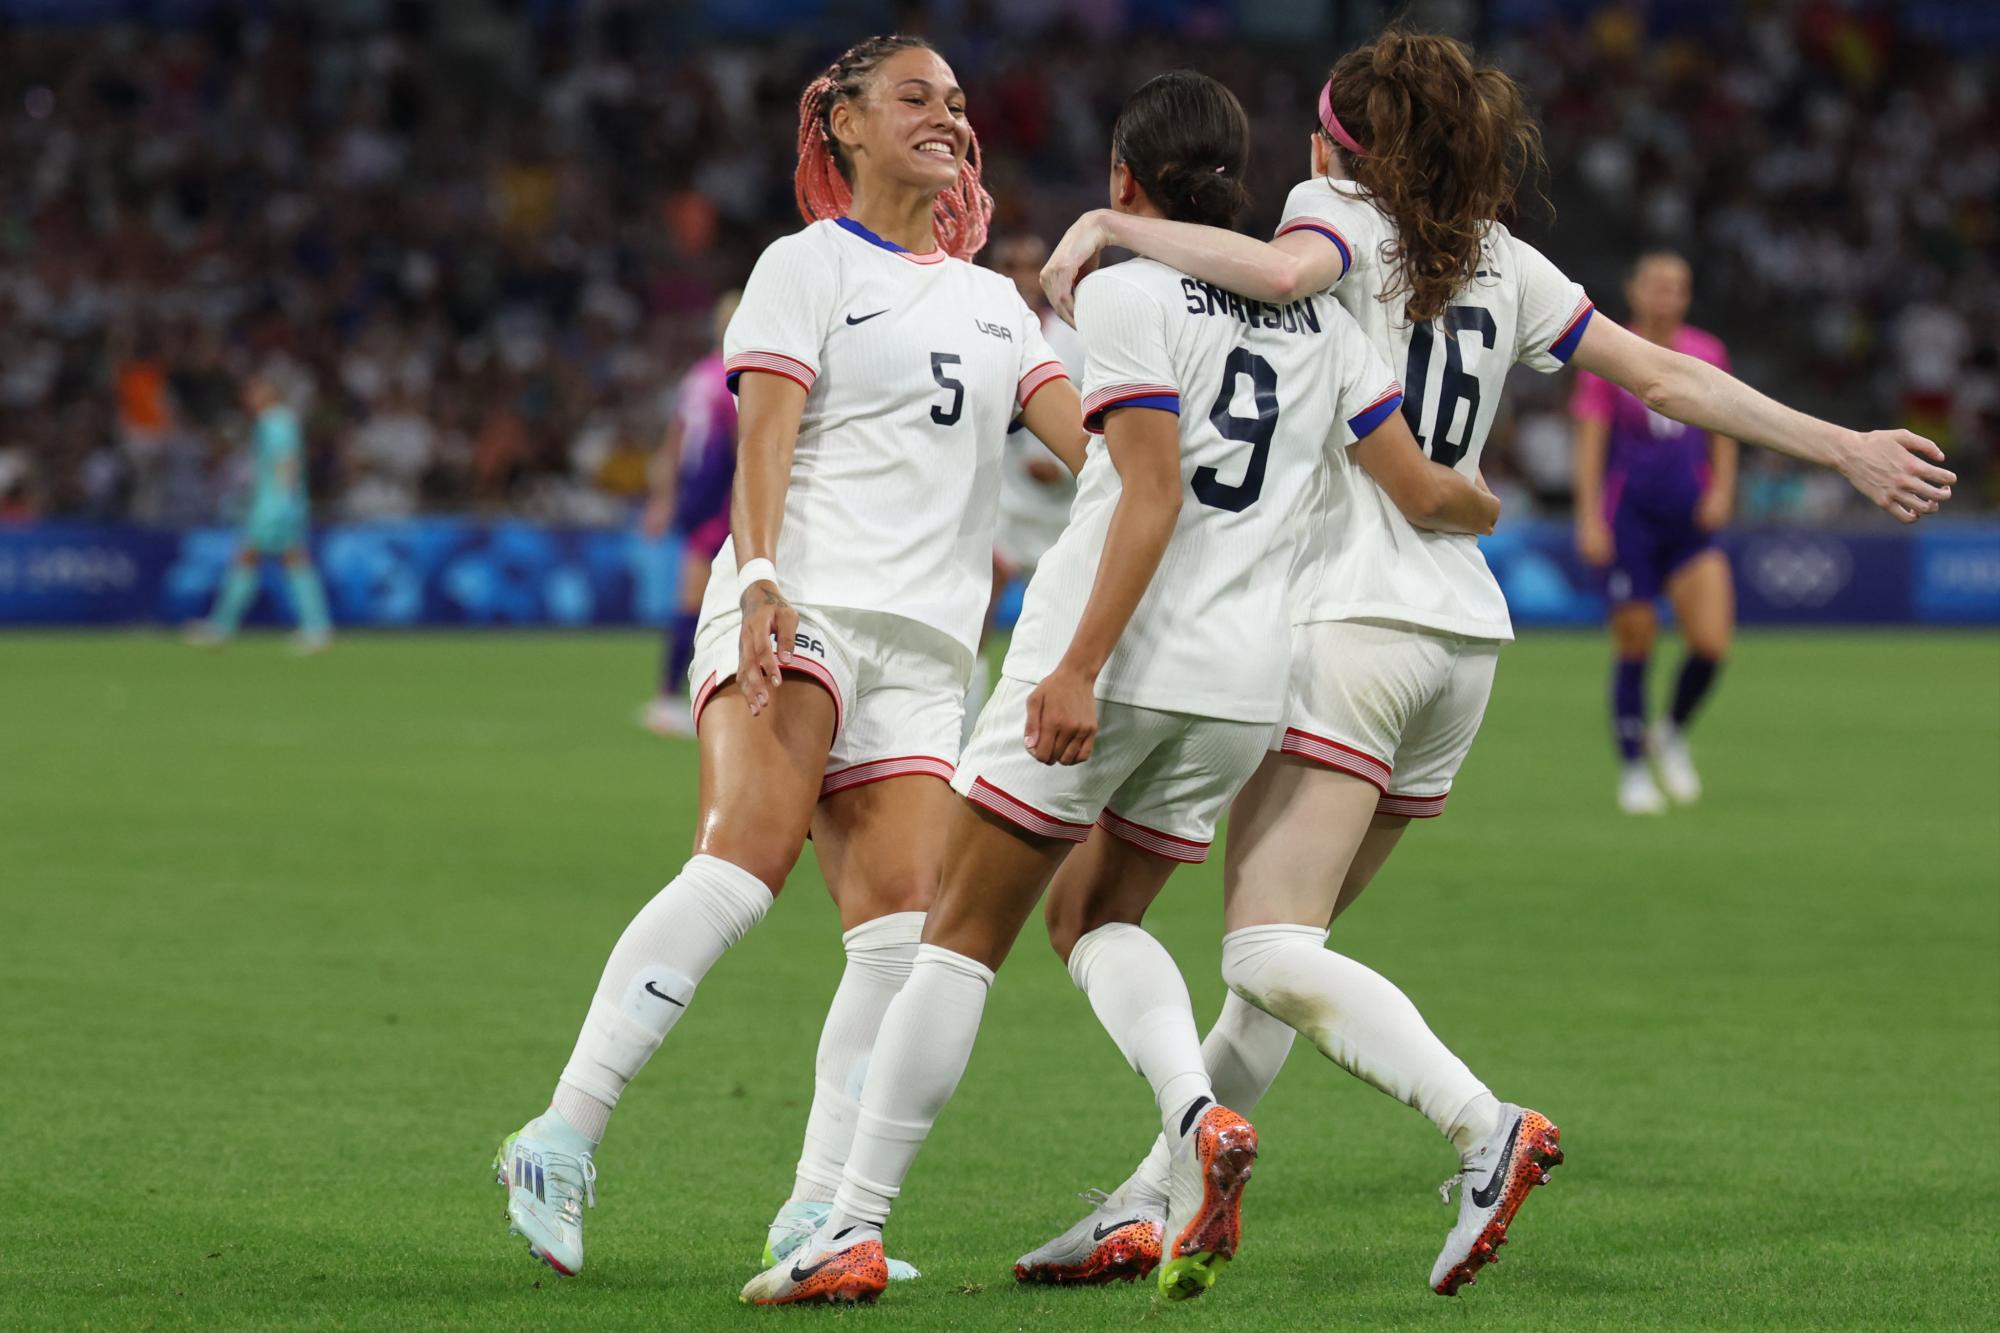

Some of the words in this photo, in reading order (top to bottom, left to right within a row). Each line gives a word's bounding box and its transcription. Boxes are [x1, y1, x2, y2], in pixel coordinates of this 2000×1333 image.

[974, 318, 1013, 343] USA
[930, 351, 965, 426] 5
[1401, 304, 1497, 469] 16
[1191, 346, 1280, 513] 9
[774, 633, 825, 658] SA
